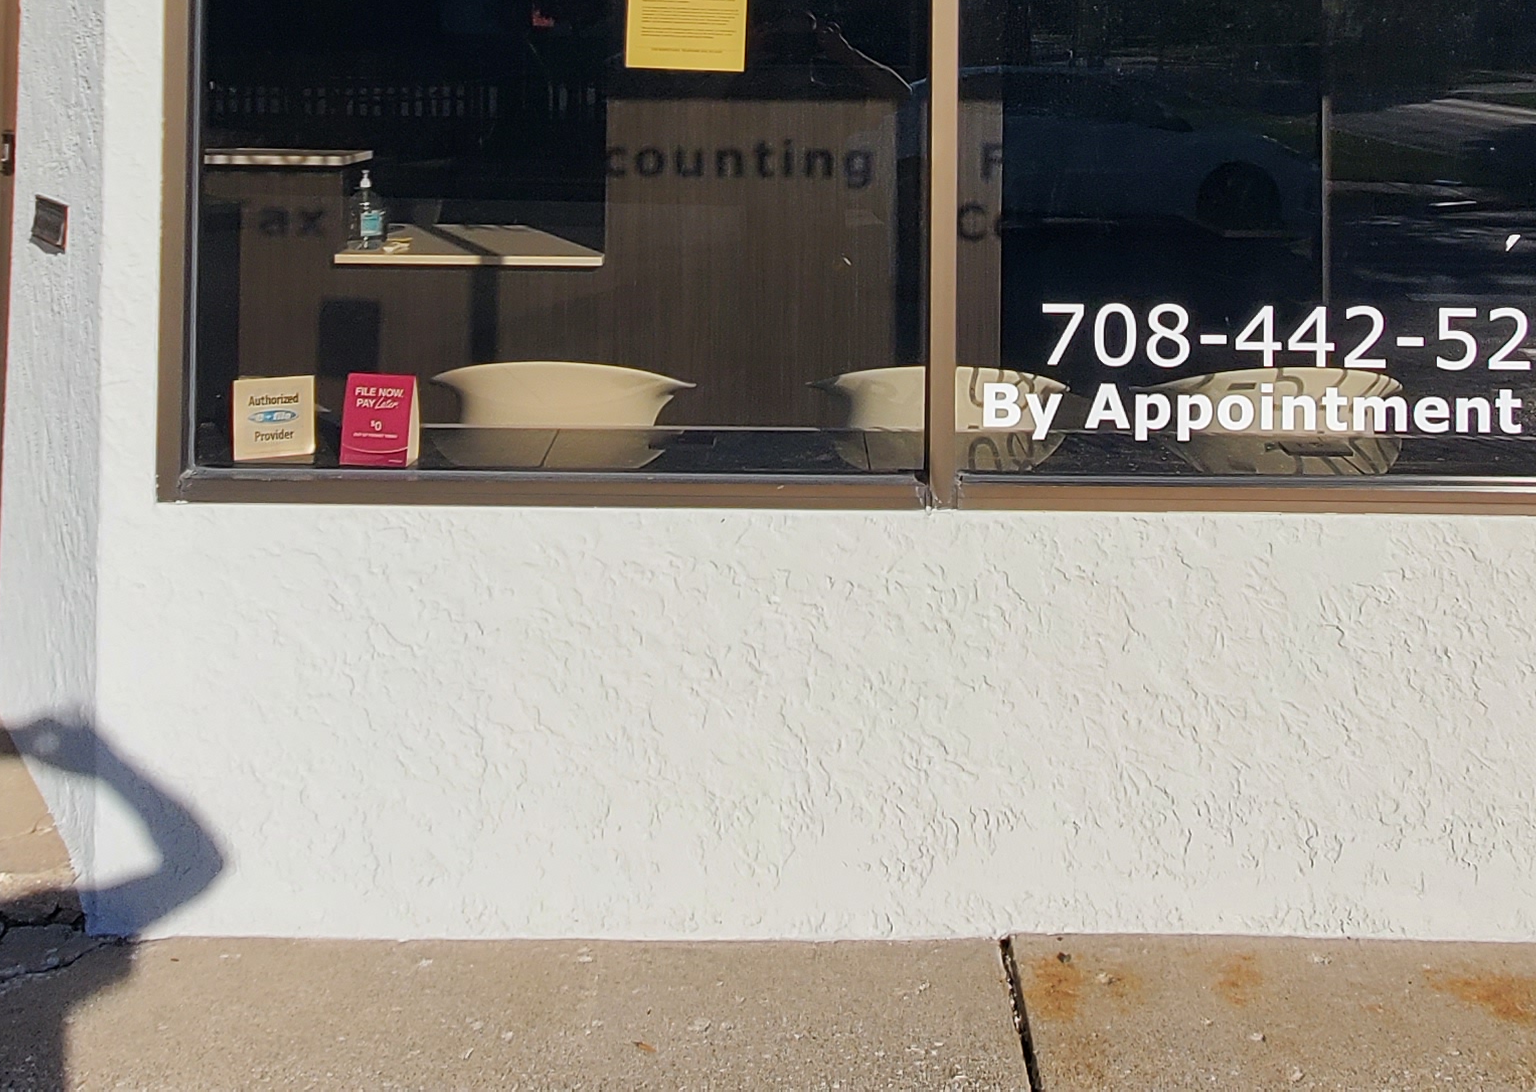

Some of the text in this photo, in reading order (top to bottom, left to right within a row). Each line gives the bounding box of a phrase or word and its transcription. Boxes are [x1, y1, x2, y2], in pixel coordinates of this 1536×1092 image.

[355, 387, 377, 396] FILE
[248, 393, 299, 406] Authorized
[356, 398, 376, 408] PAY
[981, 381, 1064, 441] By
[1083, 381, 1523, 442] Appointment
[254, 429, 294, 442] Provider
